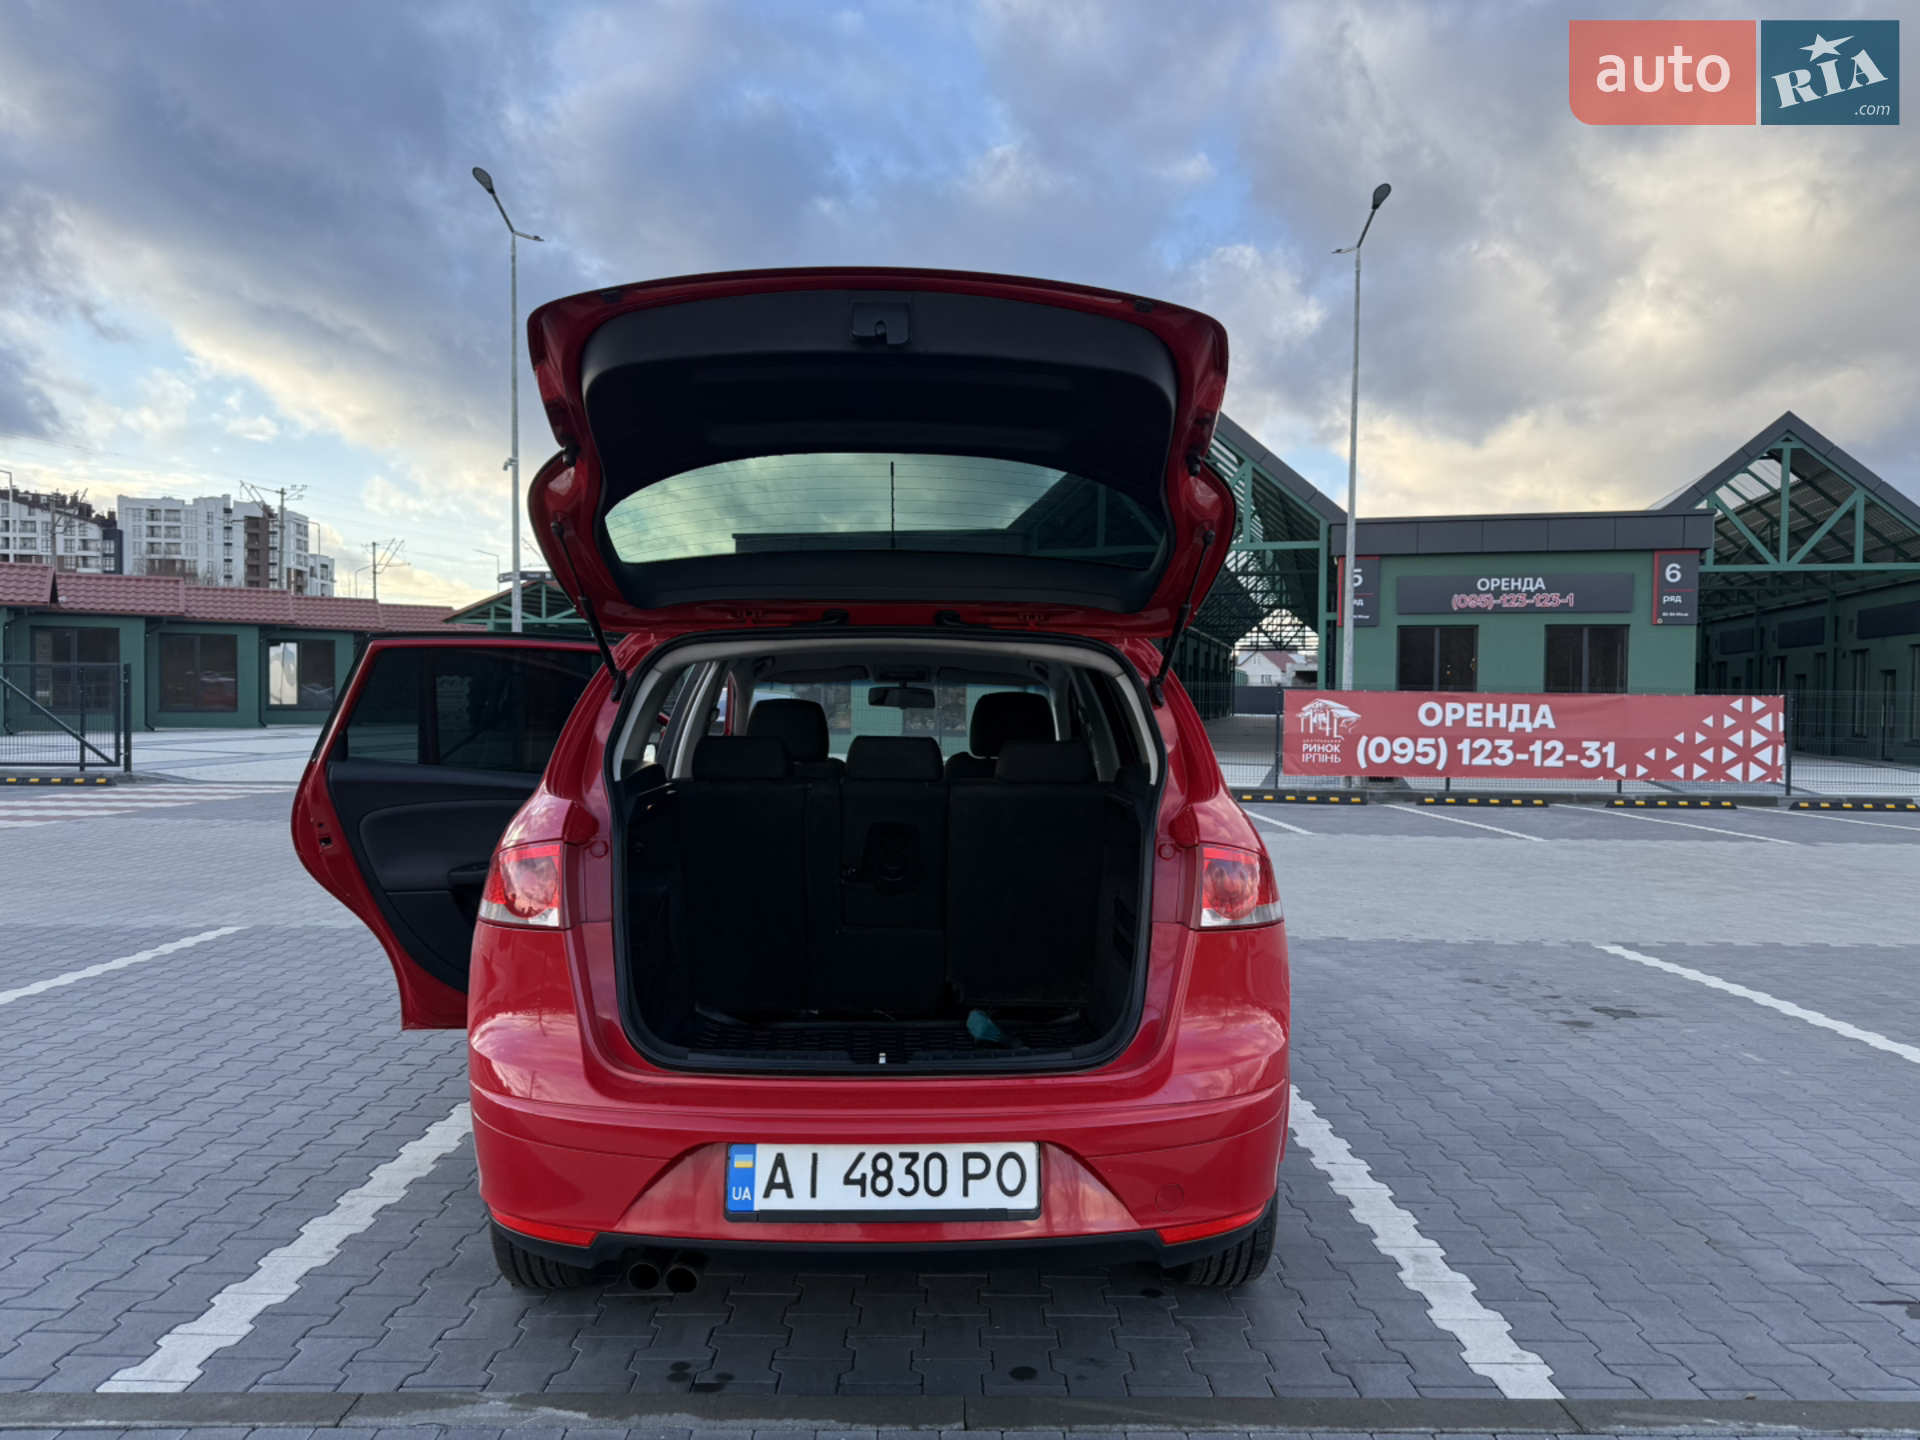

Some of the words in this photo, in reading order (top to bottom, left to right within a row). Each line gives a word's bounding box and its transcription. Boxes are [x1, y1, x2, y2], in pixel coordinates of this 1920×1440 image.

[1665, 562, 1682, 583] 6
[1476, 577, 1546, 592] ОРЕНДА
[1662, 595, 1682, 604] ряд
[1417, 701, 1556, 733] ОРЕНДА
[1302, 743, 1341, 753] РИНОК
[1356, 735, 1448, 771] (095)
[1457, 738, 1616, 768] 123-12-31
[1302, 753, 1342, 764] ІРПІНЬ
[843, 1151, 948, 1198] 4830
[732, 1187, 752, 1201] UA
